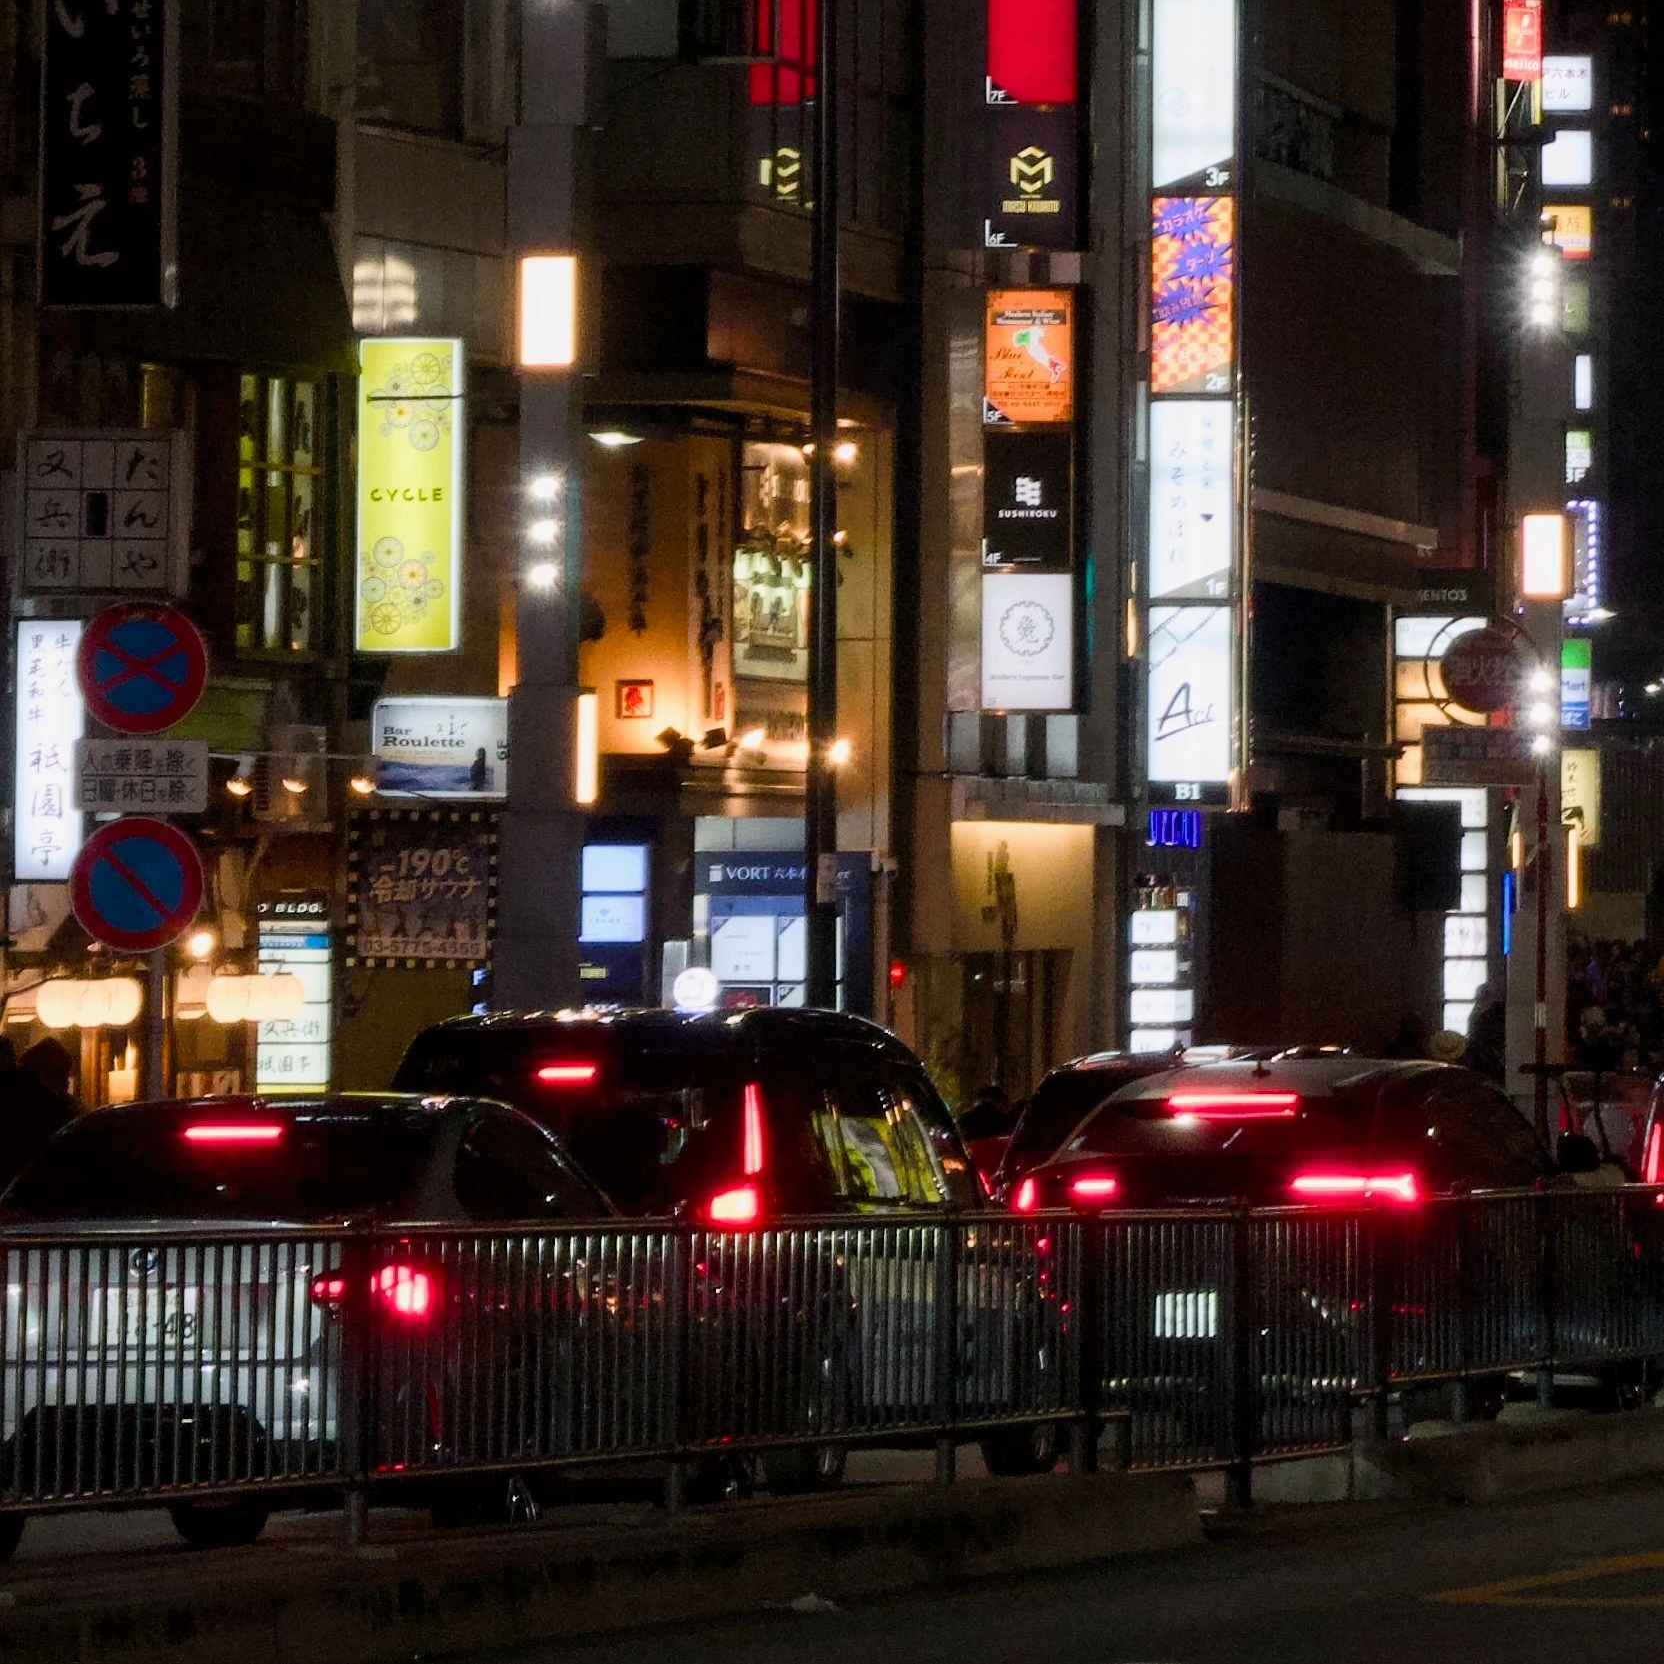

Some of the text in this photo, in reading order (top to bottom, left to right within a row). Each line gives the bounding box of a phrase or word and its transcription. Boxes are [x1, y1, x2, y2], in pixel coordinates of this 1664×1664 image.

[1206, 168, 1229, 187] 3F
[1161, 207, 1204, 233] カラオケ
[1205, 373, 1228, 390] 2F
[987, 411, 1001, 423] 5F
[370, 487, 444, 502] CYCLE
[120, 447, 158, 579] たんや
[998, 509, 1057, 519] SUSHIROKU
[1205, 577, 1227, 596] 1F
[382, 726, 412, 737] Bar
[381, 735, 465, 749] Roulette
[81, 749, 197, 772] 人の乗降を除く
[1174, 783, 1200, 800] B1
[726, 867, 769, 880] VORT
[368, 874, 481, 903] 冷却サウナ
[275, 903, 323, 913] BLDG.
